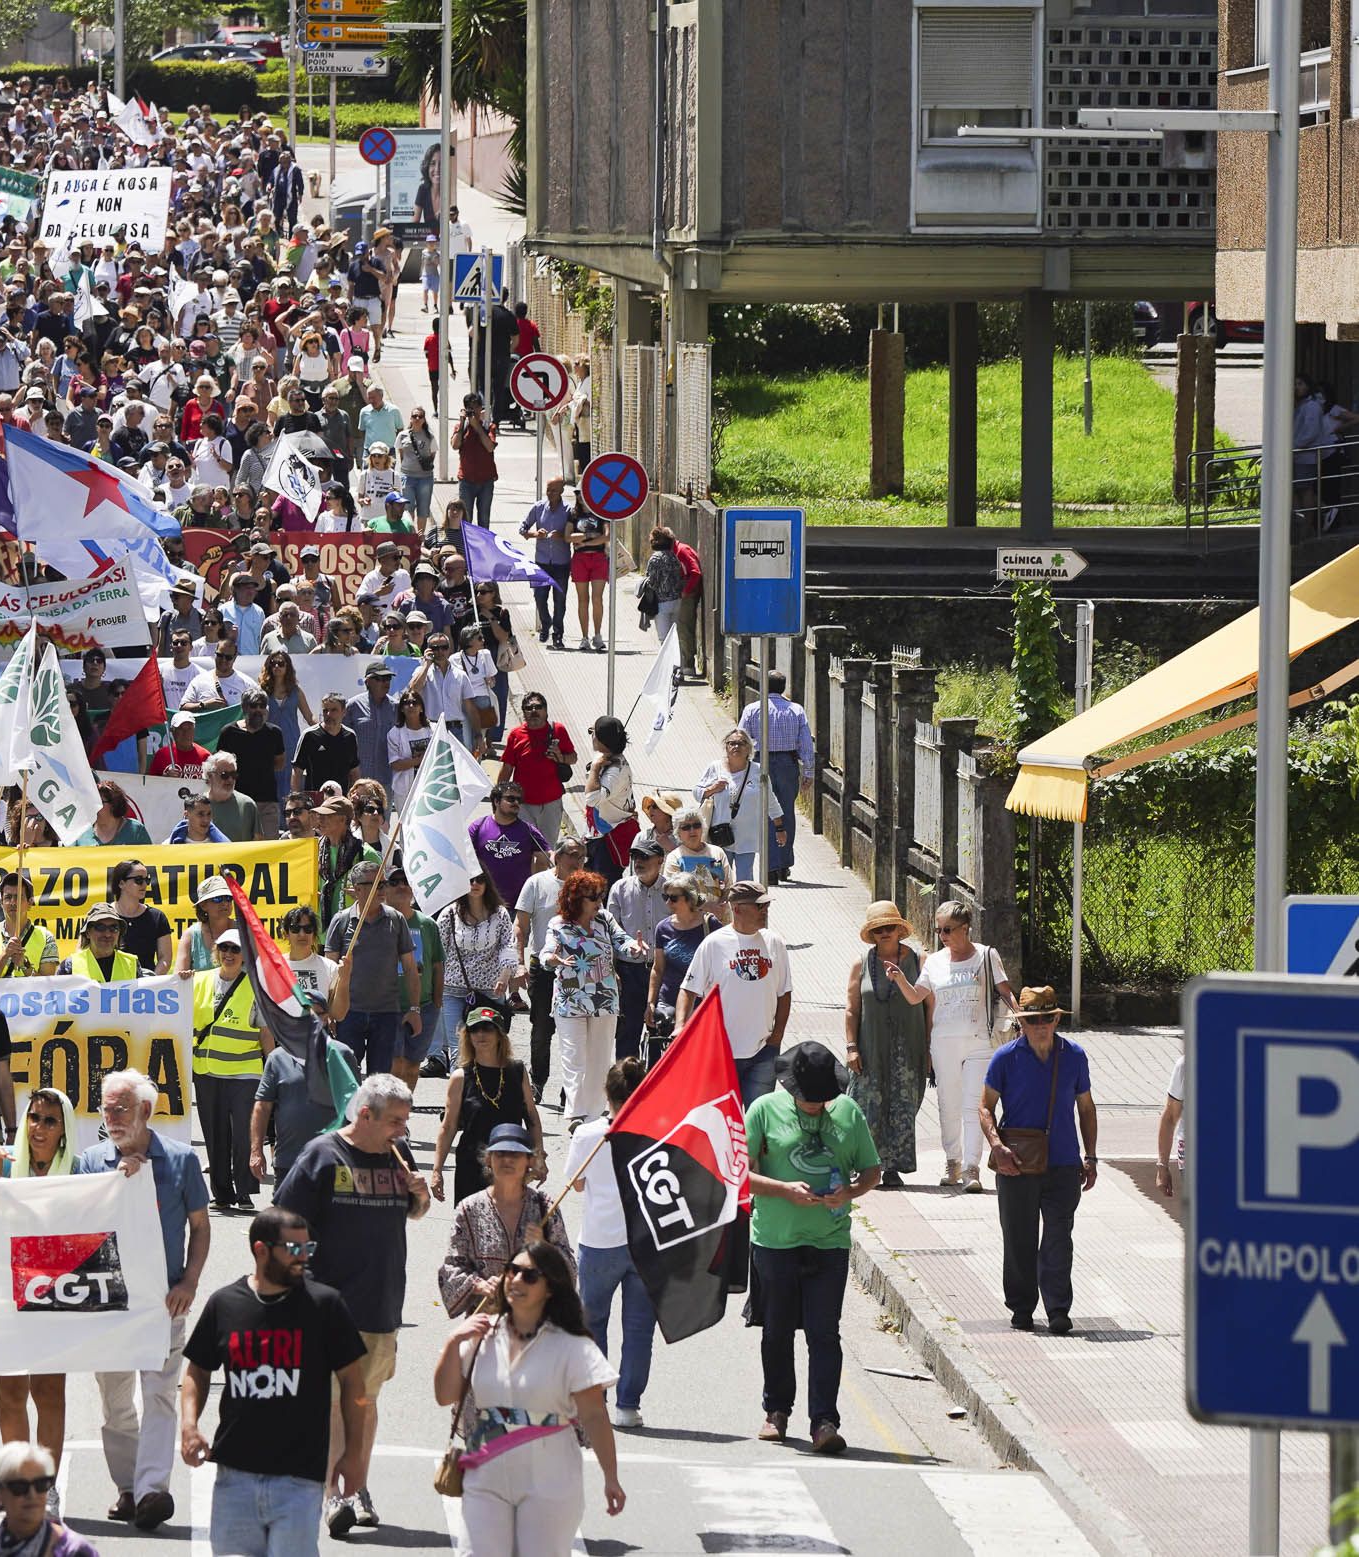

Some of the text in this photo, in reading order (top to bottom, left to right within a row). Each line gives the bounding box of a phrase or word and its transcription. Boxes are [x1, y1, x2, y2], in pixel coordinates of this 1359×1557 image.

[52, 181, 59, 195] A
[64, 180, 98, 193] AUGA
[79, 197, 122, 214] E NON
[75, 223, 150, 239] ELULOSA
[1003, 554, 1042, 564] CLÍNICA
[1002, 568, 1068, 577] VETERINARIA
[0, 592, 21, 612] ÁS
[72, 598, 89, 611] DA
[93, 587, 130, 604] TERRA
[96, 614, 128, 628] ERGUER
[106, 863, 298, 905] ATURAL
[100, 985, 179, 1015] rías
[1265, 1043, 1359, 1198] P
[639, 1151, 695, 1229] CGT
[24, 1272, 114, 1305] CGT
[228, 1328, 303, 1369] ALTRI
[229, 1364, 301, 1399] NON
